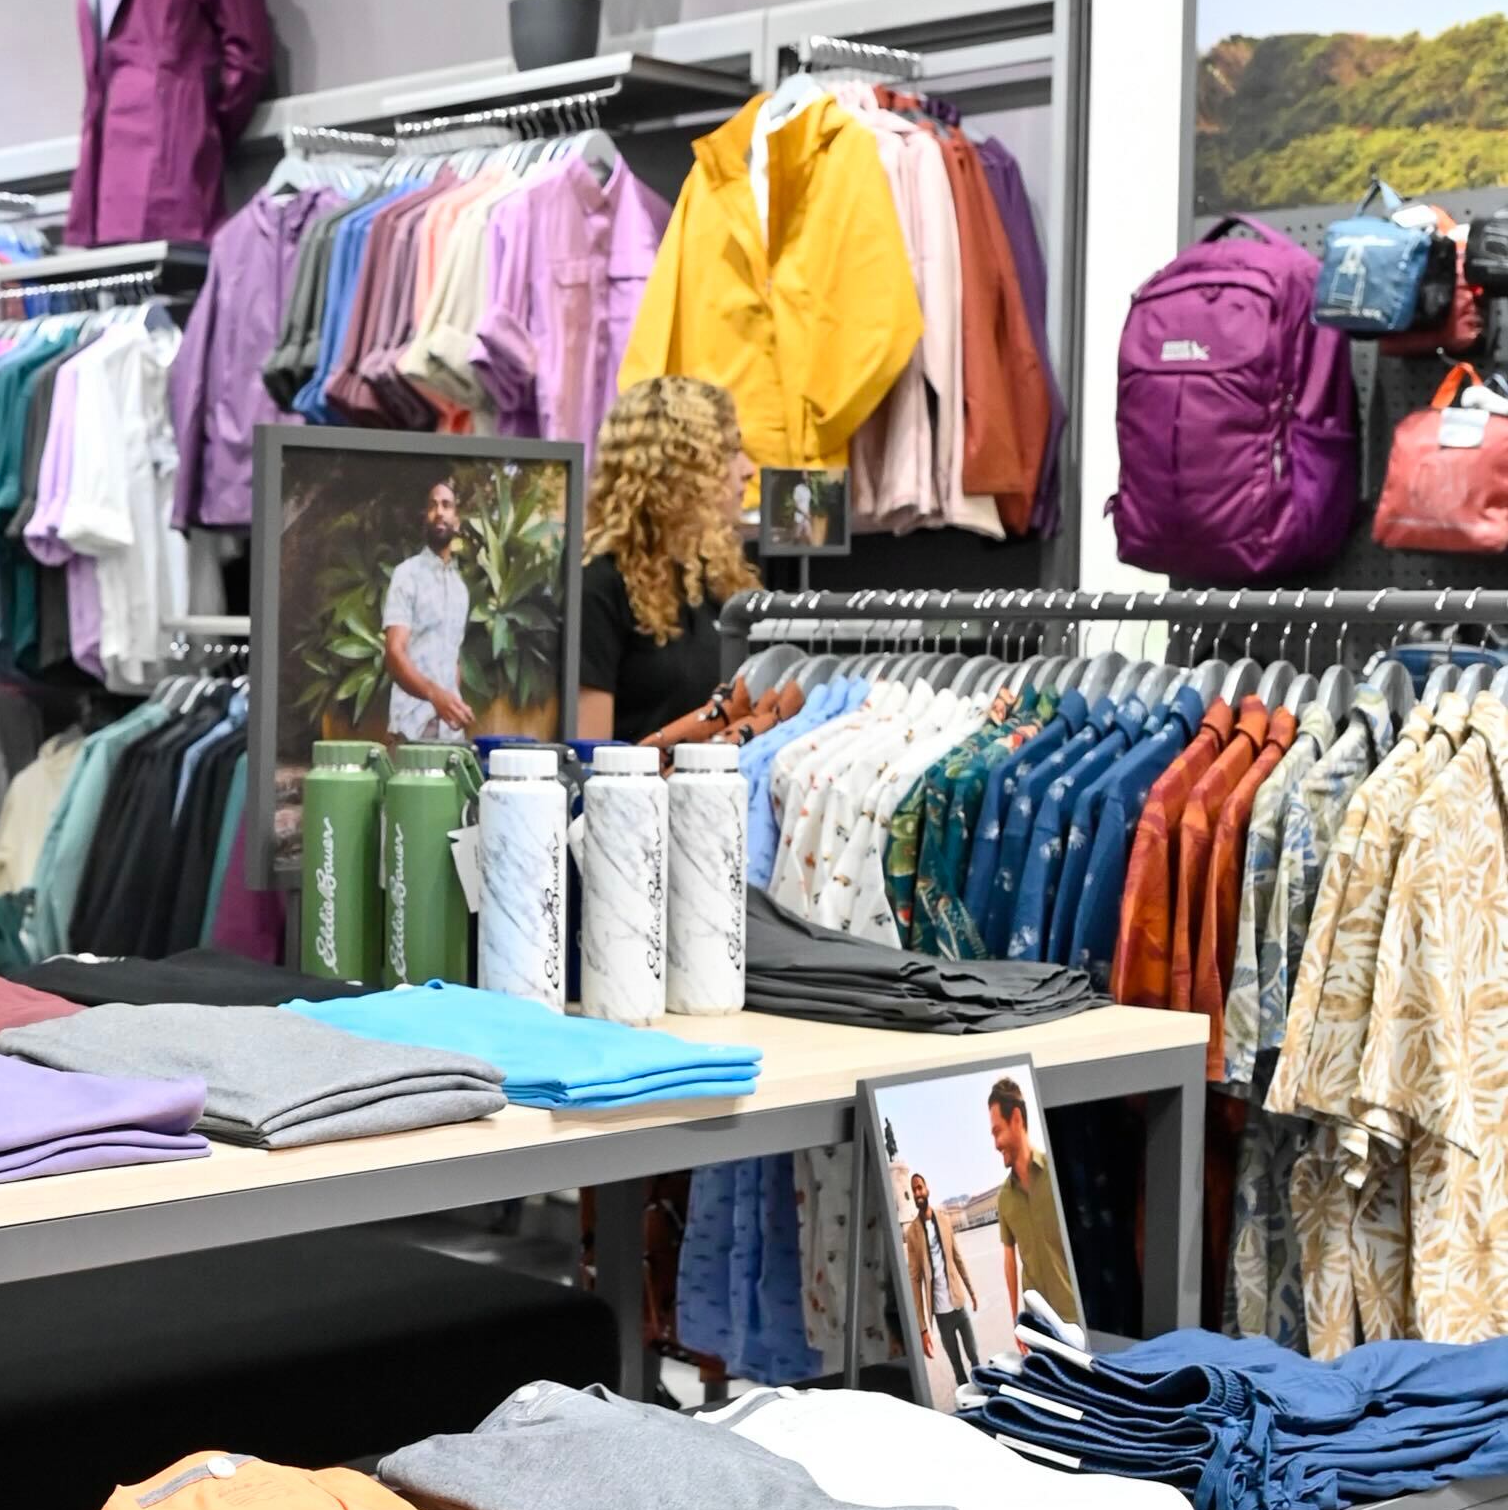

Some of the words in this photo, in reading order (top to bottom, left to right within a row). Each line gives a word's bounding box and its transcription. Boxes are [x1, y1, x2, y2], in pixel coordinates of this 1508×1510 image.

[316, 817, 337, 899] Bauer
[389, 823, 406, 907] Bauer
[316, 900, 339, 975] Eddie
[389, 907, 408, 983] Eddie
